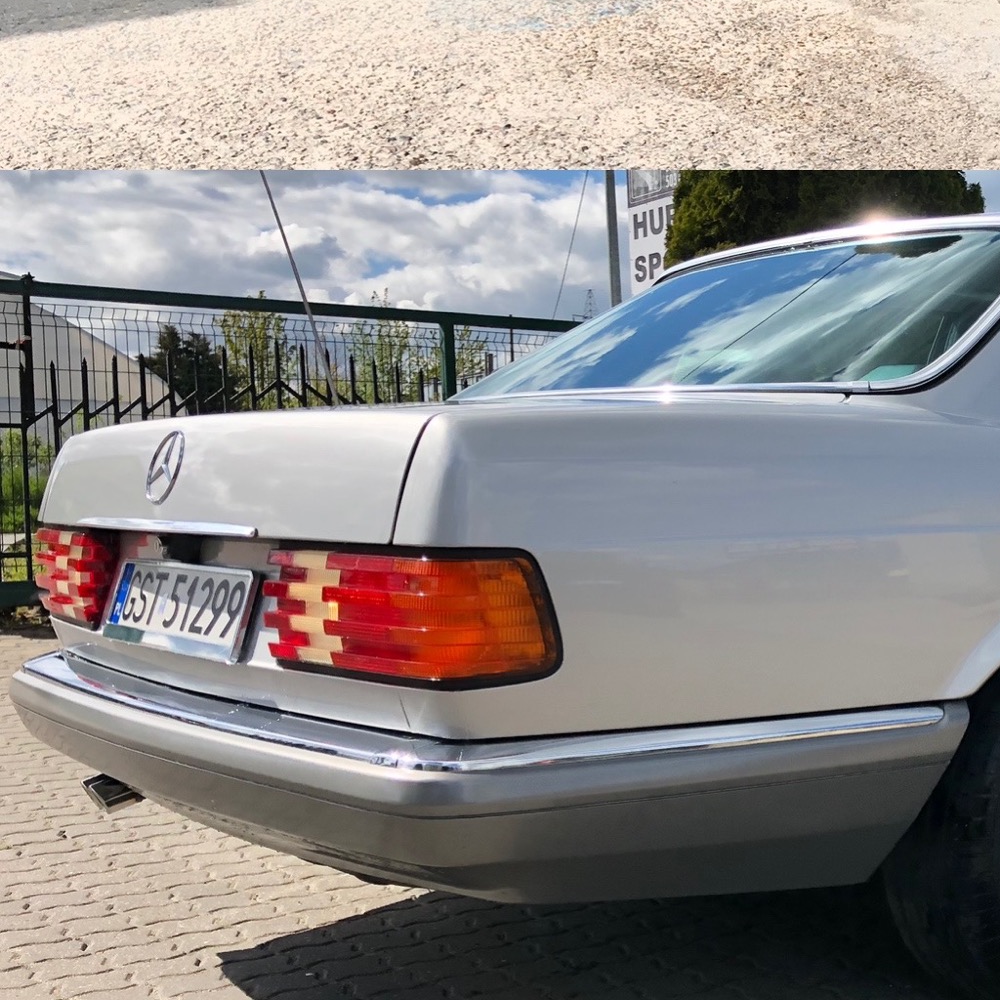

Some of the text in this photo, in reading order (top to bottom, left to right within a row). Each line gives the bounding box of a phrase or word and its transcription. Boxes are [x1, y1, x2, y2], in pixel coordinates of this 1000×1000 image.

[634, 252, 662, 283] SP
[122, 570, 246, 639] GST 51299
